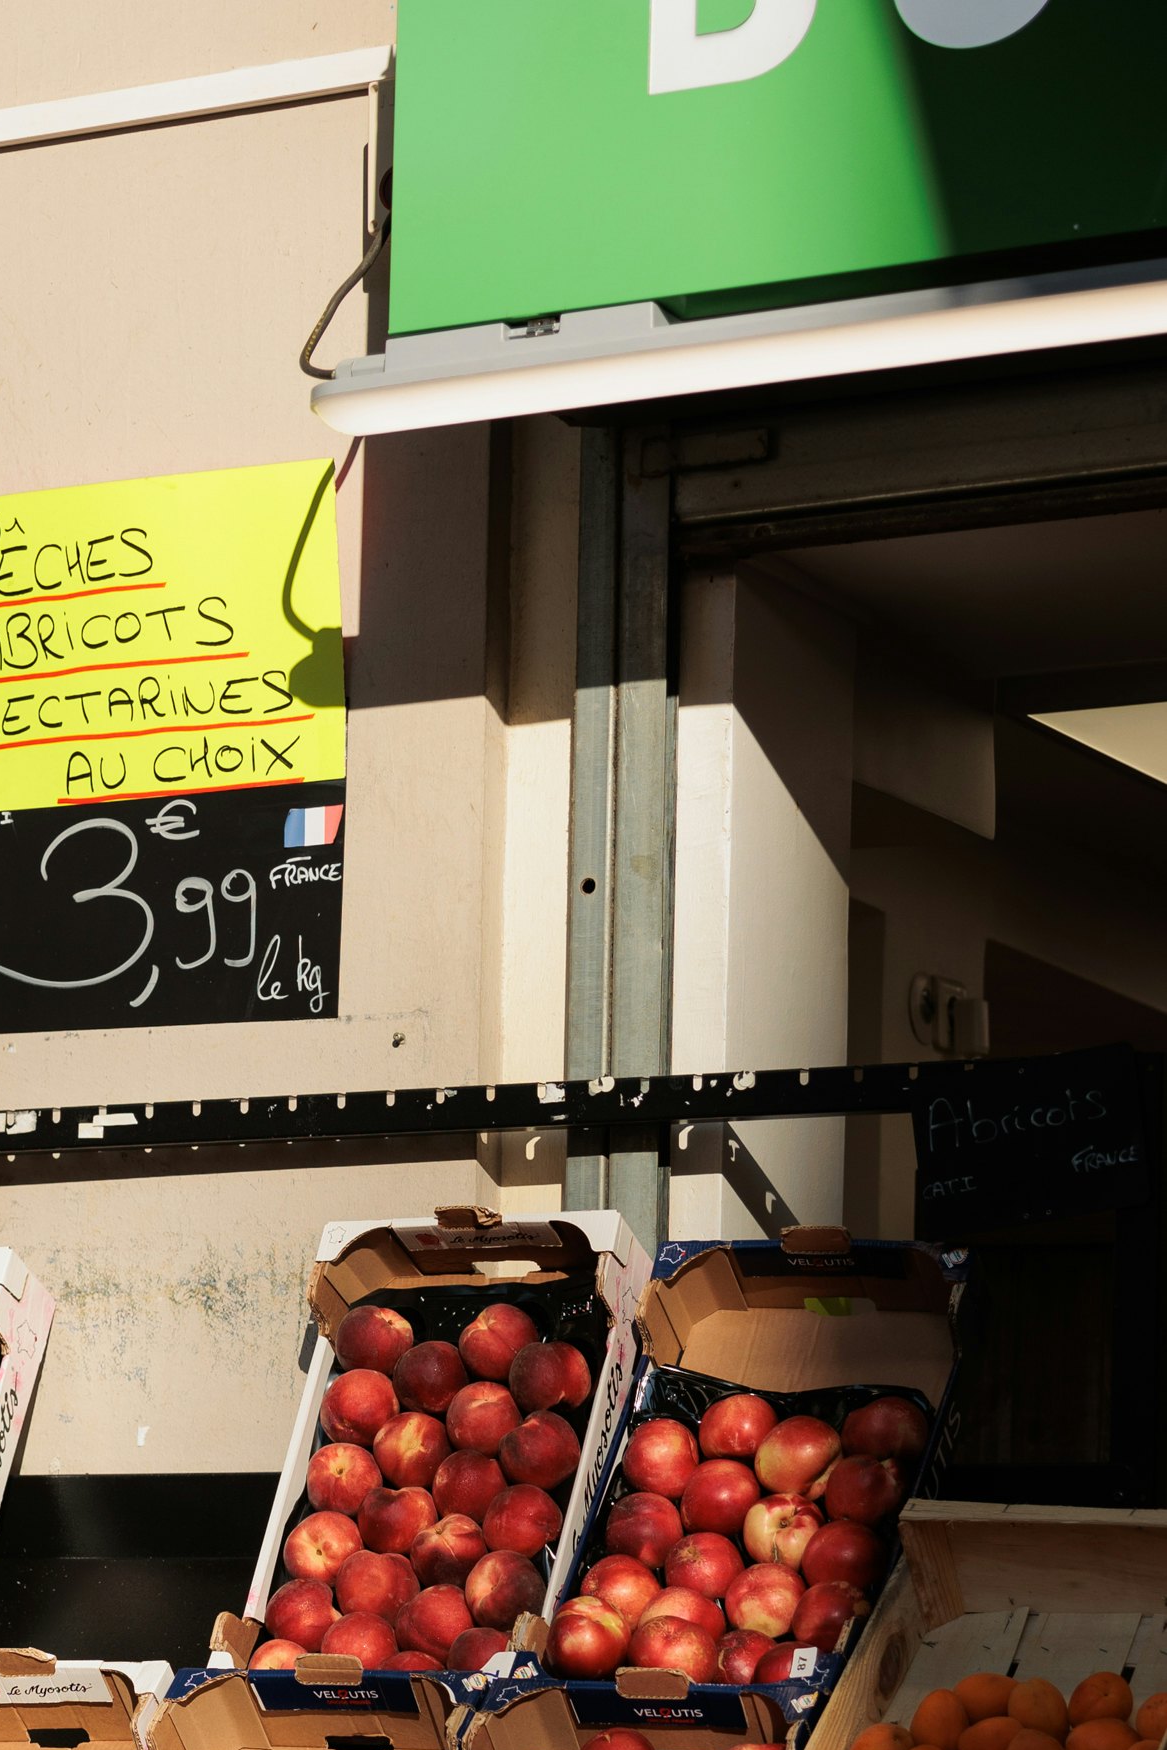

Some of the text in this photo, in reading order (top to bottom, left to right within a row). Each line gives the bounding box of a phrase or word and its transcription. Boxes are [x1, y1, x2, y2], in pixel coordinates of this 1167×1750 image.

[65, 751, 126, 795] AU
[269, 856, 342, 890] FRANCE
[257, 935, 330, 1013] le kg
[927, 1087, 1107, 1153] Abricots
[1070, 1144, 1139, 1174] FRANCE
[796, 1656, 808, 1671] 87
[7, 1682, 93, 1698] Le Myosotis
